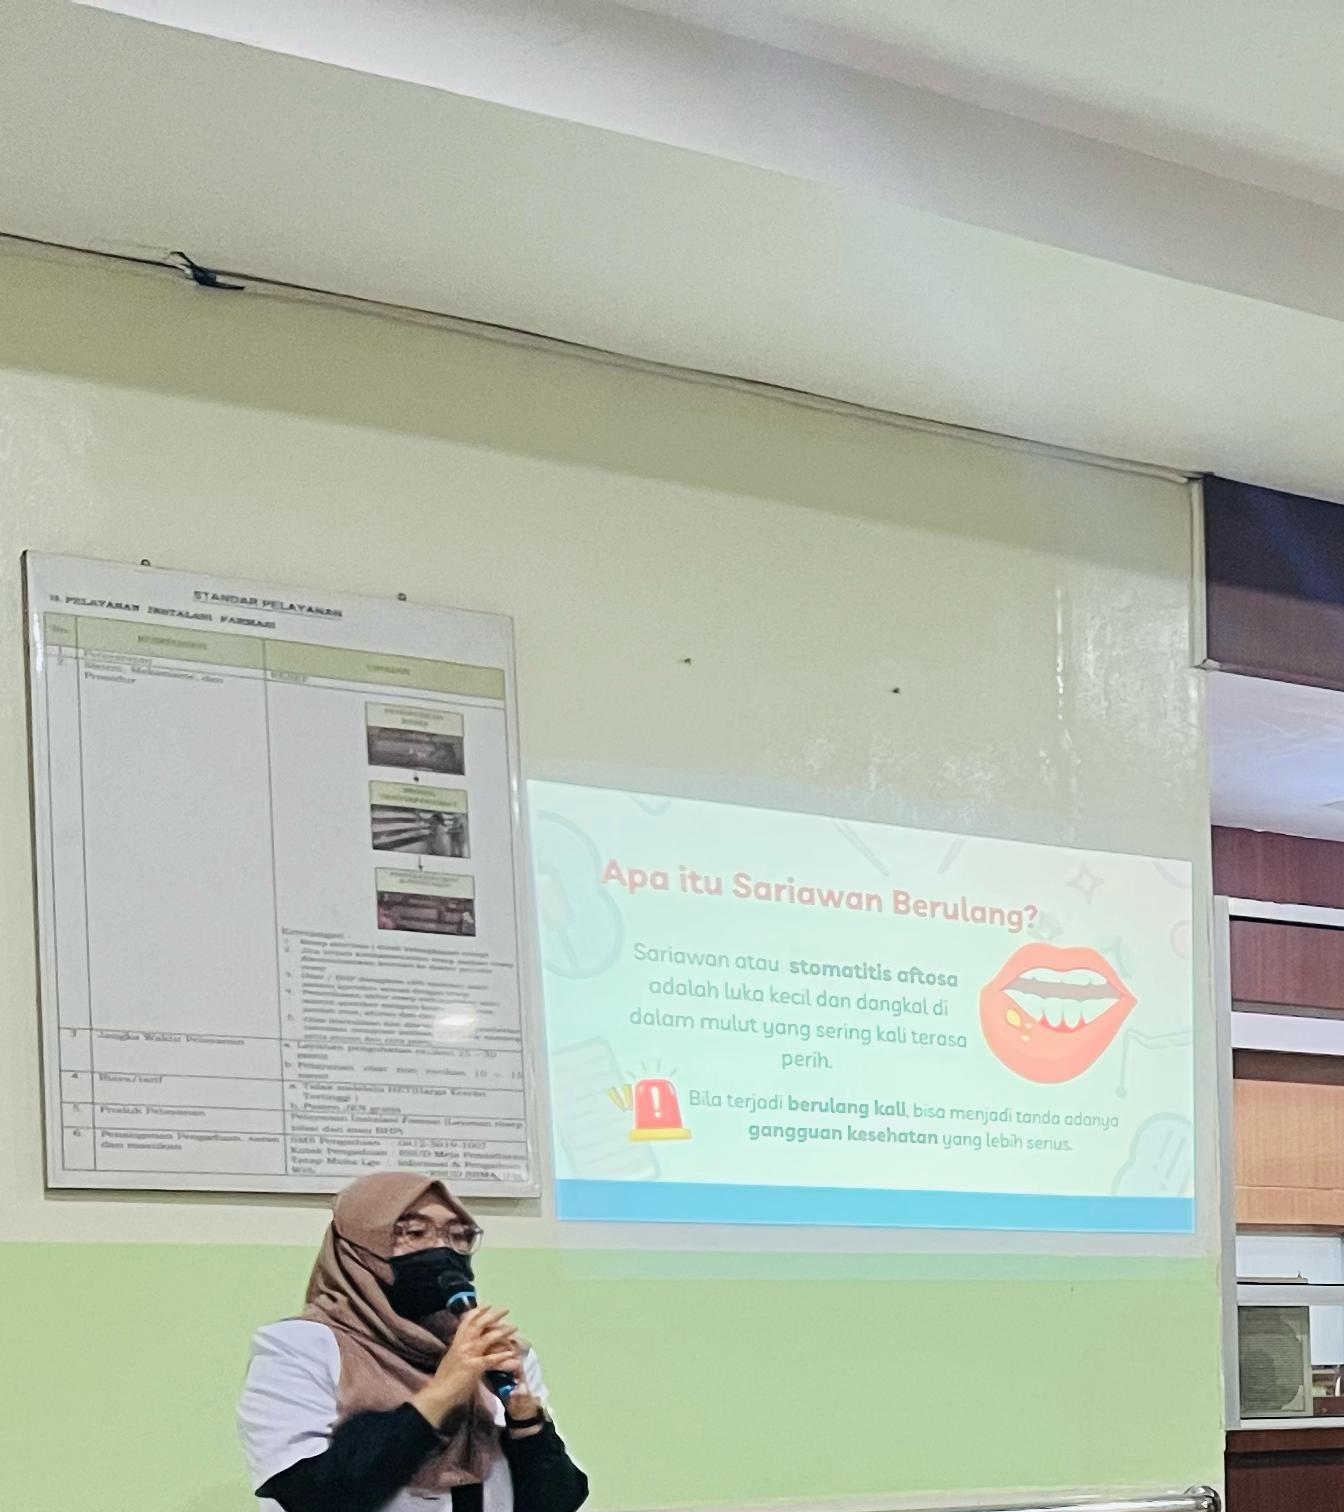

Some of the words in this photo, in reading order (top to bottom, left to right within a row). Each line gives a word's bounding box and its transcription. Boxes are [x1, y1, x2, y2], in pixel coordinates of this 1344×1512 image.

[193, 590, 258, 607] STANDAR
[262, 600, 343, 618] PELAYANAN
[601, 859, 669, 894] Apa
[679, 865, 723, 896] itu
[732, 872, 883, 912] Sariawan
[892, 889, 1038, 933] Berulang?
[633, 942, 730, 968] Sariawan
[735, 956, 780, 972] atau
[789, 959, 892, 982] stomatitis
[897, 966, 958, 988] aftosa
[649, 977, 719, 999] adalah
[724, 982, 764, 1002] luka
[770, 985, 812, 1006] kecil
[816, 990, 851, 1009] dan
[857, 993, 928, 1017] dangkal
[932, 999, 949, 1017] di
[630, 1007, 694, 1029] dalam
[700, 1014, 758, 1033] mulut
[763, 1022, 811, 1041] yang
[816, 1023, 871, 1045] sering
[876, 1026, 907, 1044] kali
[911, 1029, 967, 1048] terasa
[781, 1050, 832, 1070] perih.
[689, 1089, 722, 1107] Bila
[727, 1093, 784, 1113] terjadi
[788, 1095, 869, 1118] berulang
[913, 1102, 945, 1119] bisa
[950, 1107, 1013, 1125] menjadi
[1016, 1110, 1060, 1125] tanda
[1064, 1112, 1119, 1131] adanya
[749, 1124, 842, 1143] gangguan
[847, 1125, 938, 1146] kesehatan
[943, 1133, 982, 1150] yang
[986, 1132, 1023, 1149] lebih
